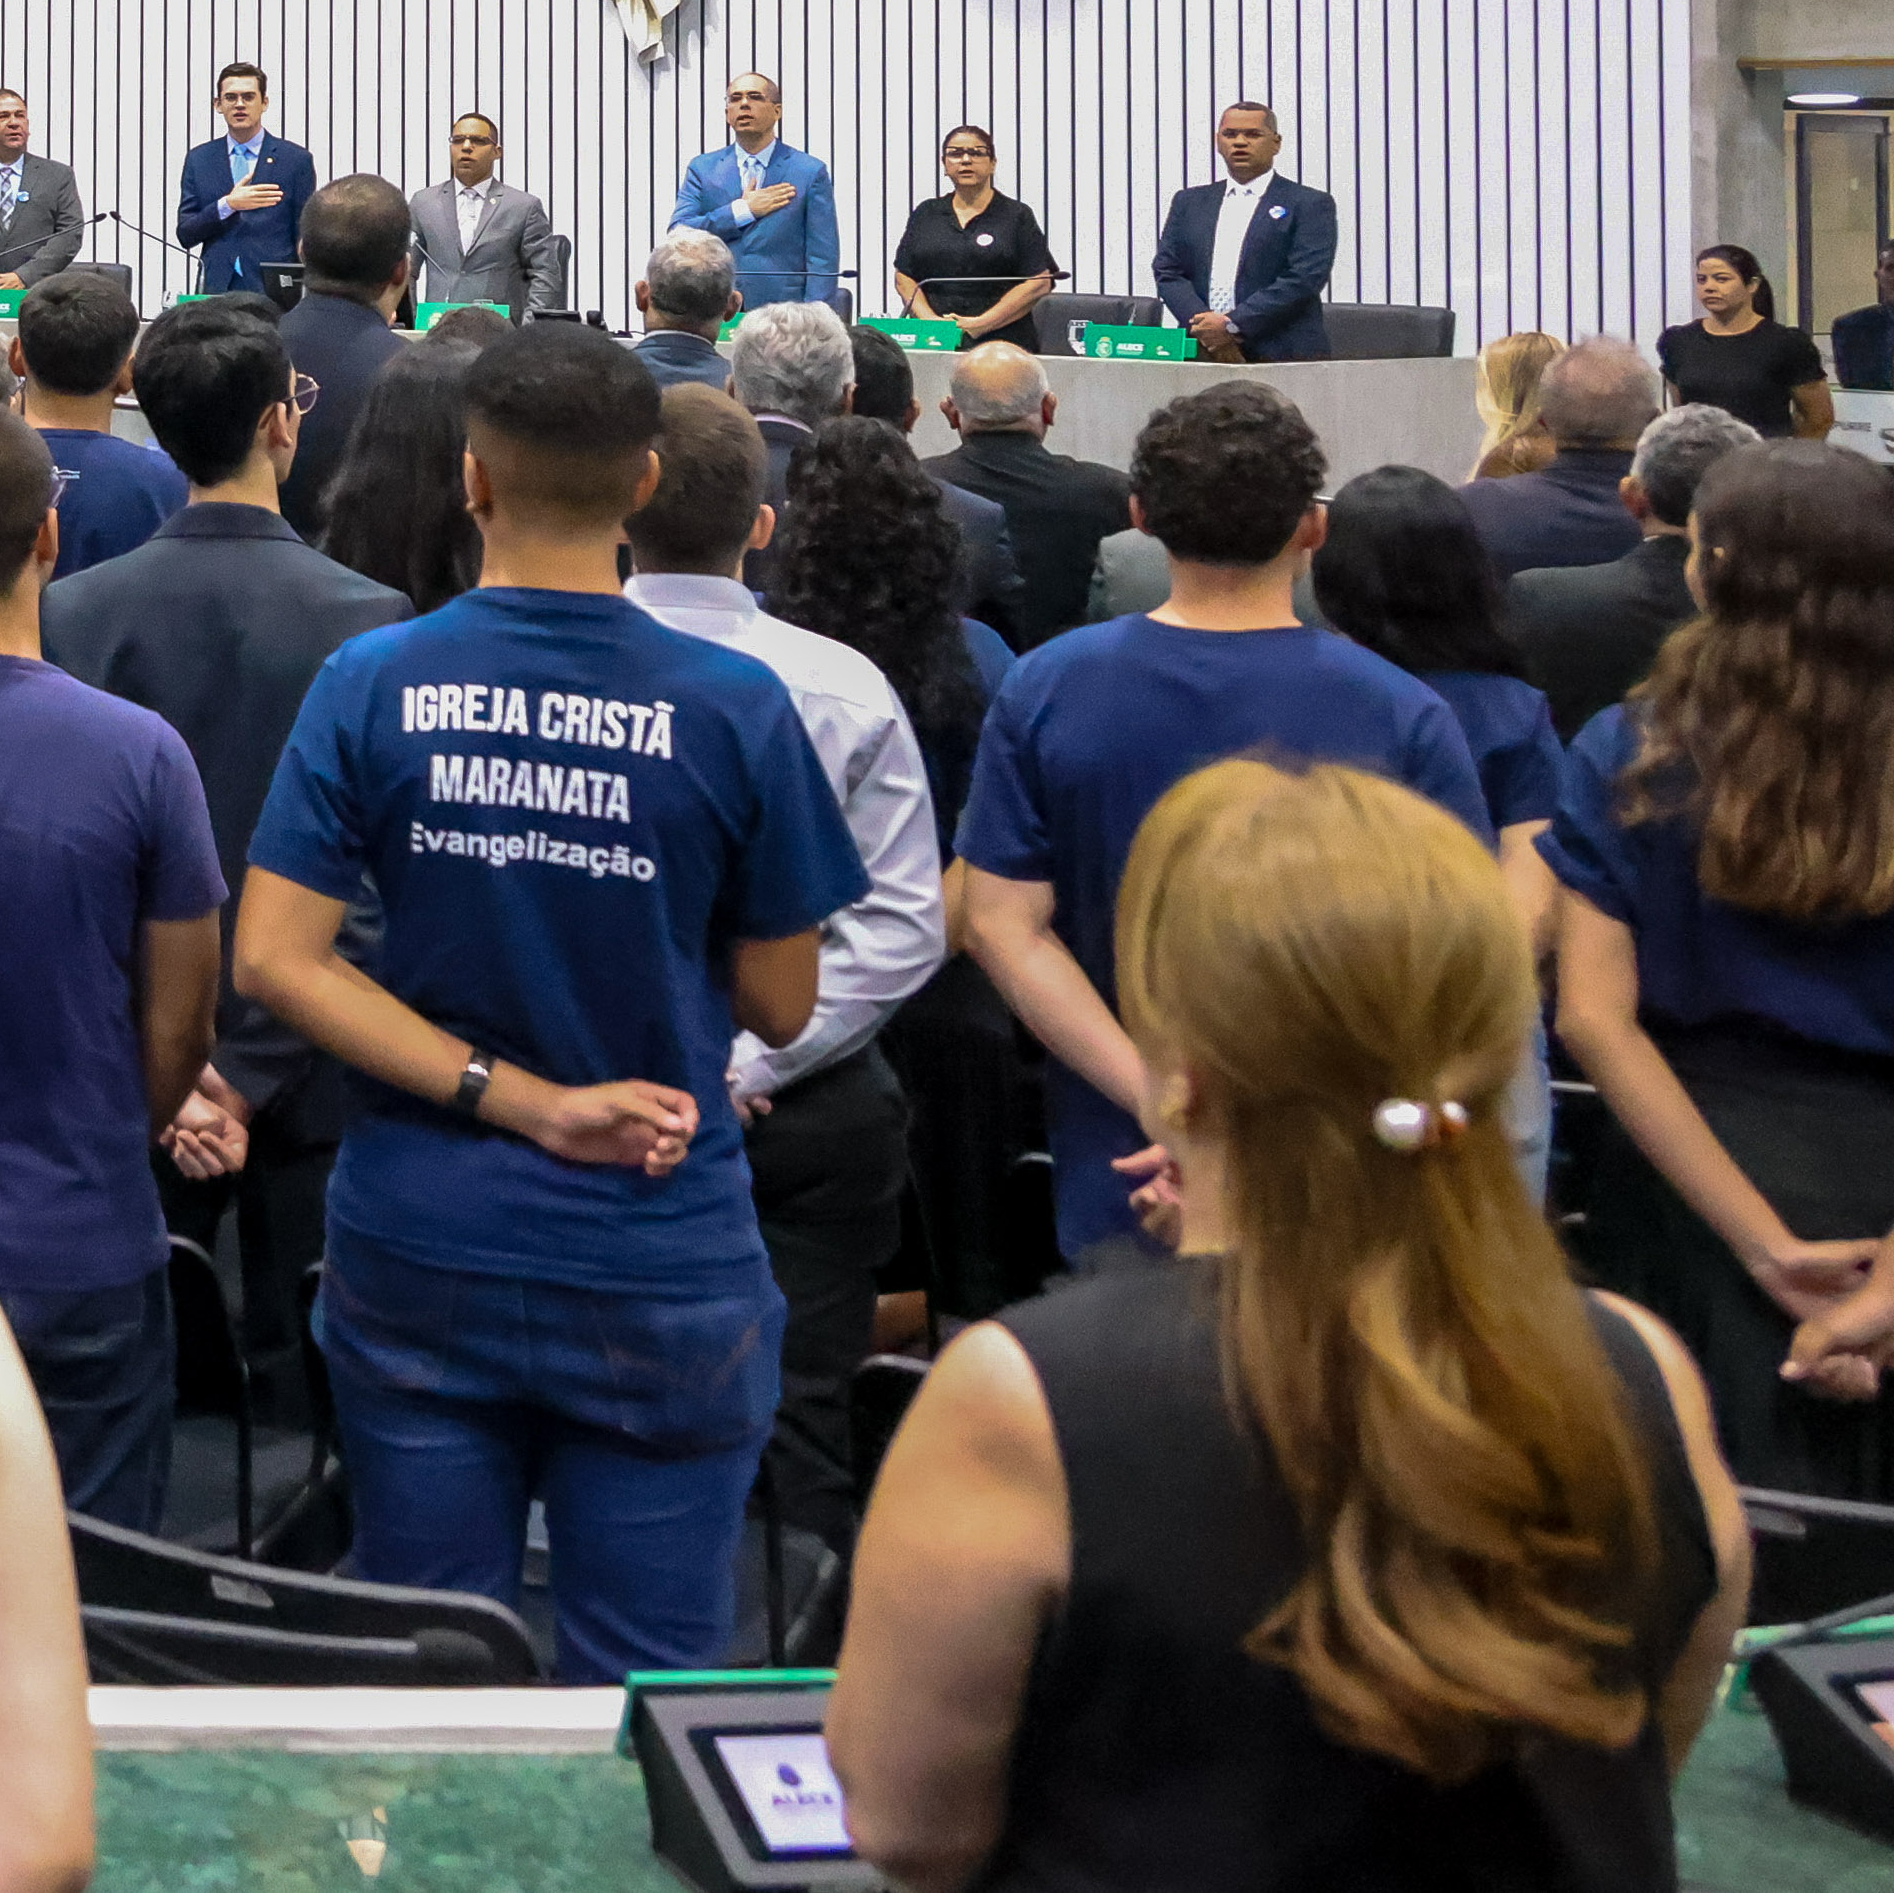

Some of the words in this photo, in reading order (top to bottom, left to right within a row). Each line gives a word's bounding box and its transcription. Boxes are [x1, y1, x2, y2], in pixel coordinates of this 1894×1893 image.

[402, 684, 529, 736] IGREJA
[538, 691, 674, 759] CRISTÃ
[430, 754, 631, 824] MARANATA
[409, 820, 656, 882] Evangelização
